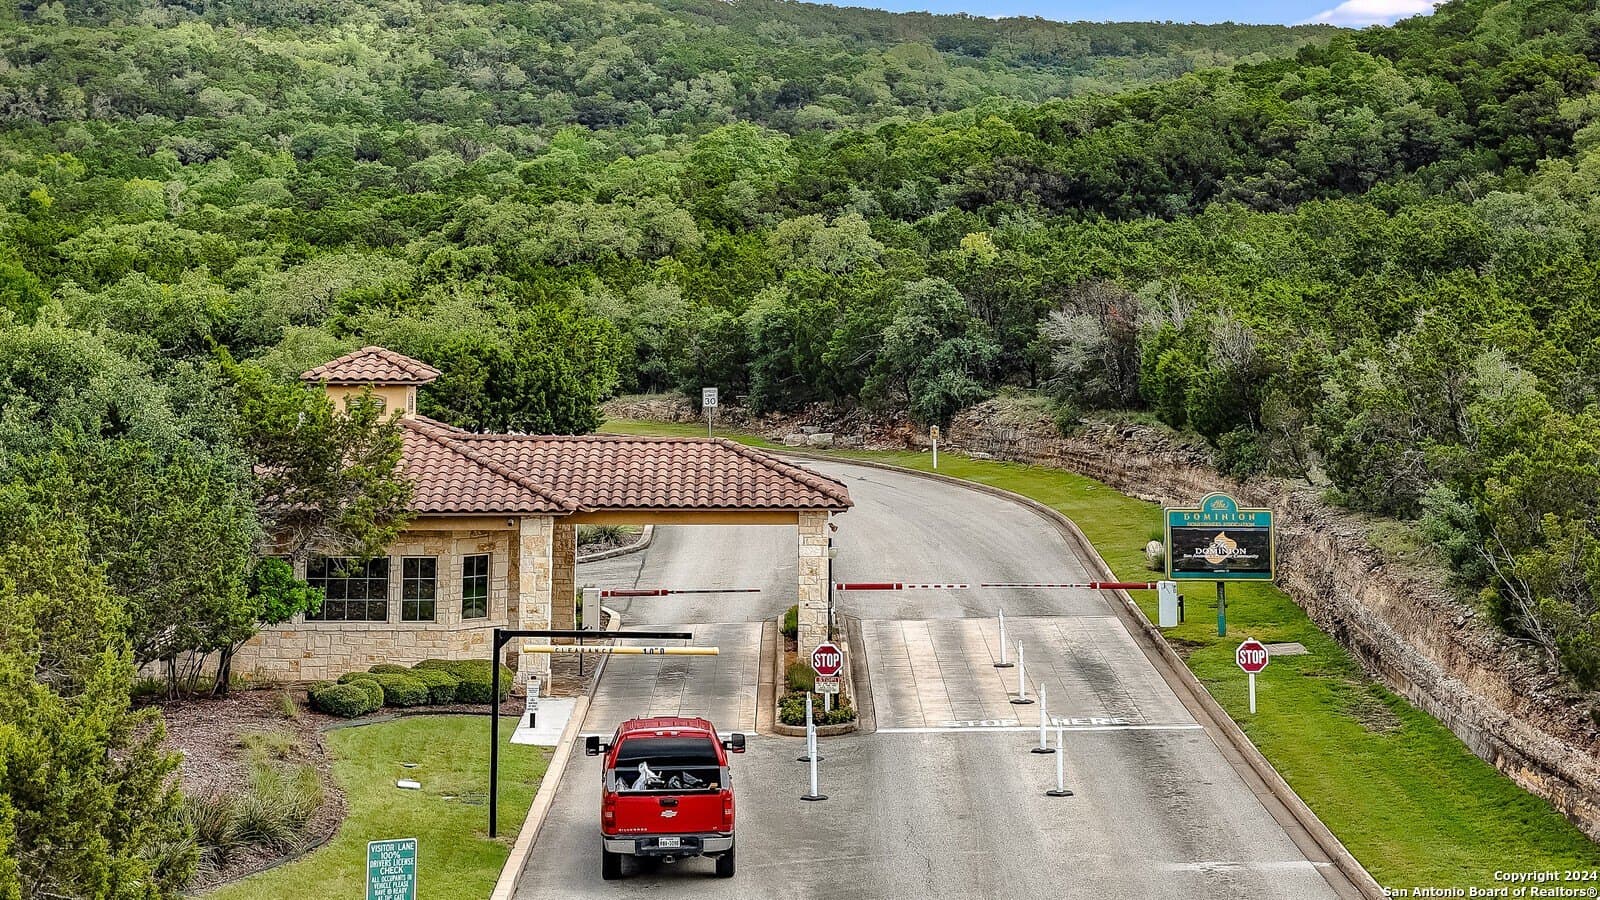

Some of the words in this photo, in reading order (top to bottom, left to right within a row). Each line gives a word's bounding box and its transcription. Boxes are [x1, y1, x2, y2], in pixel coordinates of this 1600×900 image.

[814, 653, 840, 668] STOP
[1240, 650, 1266, 665] STOP
[943, 719, 1019, 727] STOP
[1051, 717, 1130, 726] HERE
[371, 844, 395, 852] VISITOR
[397, 842, 415, 850] LANE
[381, 851, 401, 860] 100%
[394, 857, 415, 866] LICENSE
[380, 866, 404, 875] CHECK
